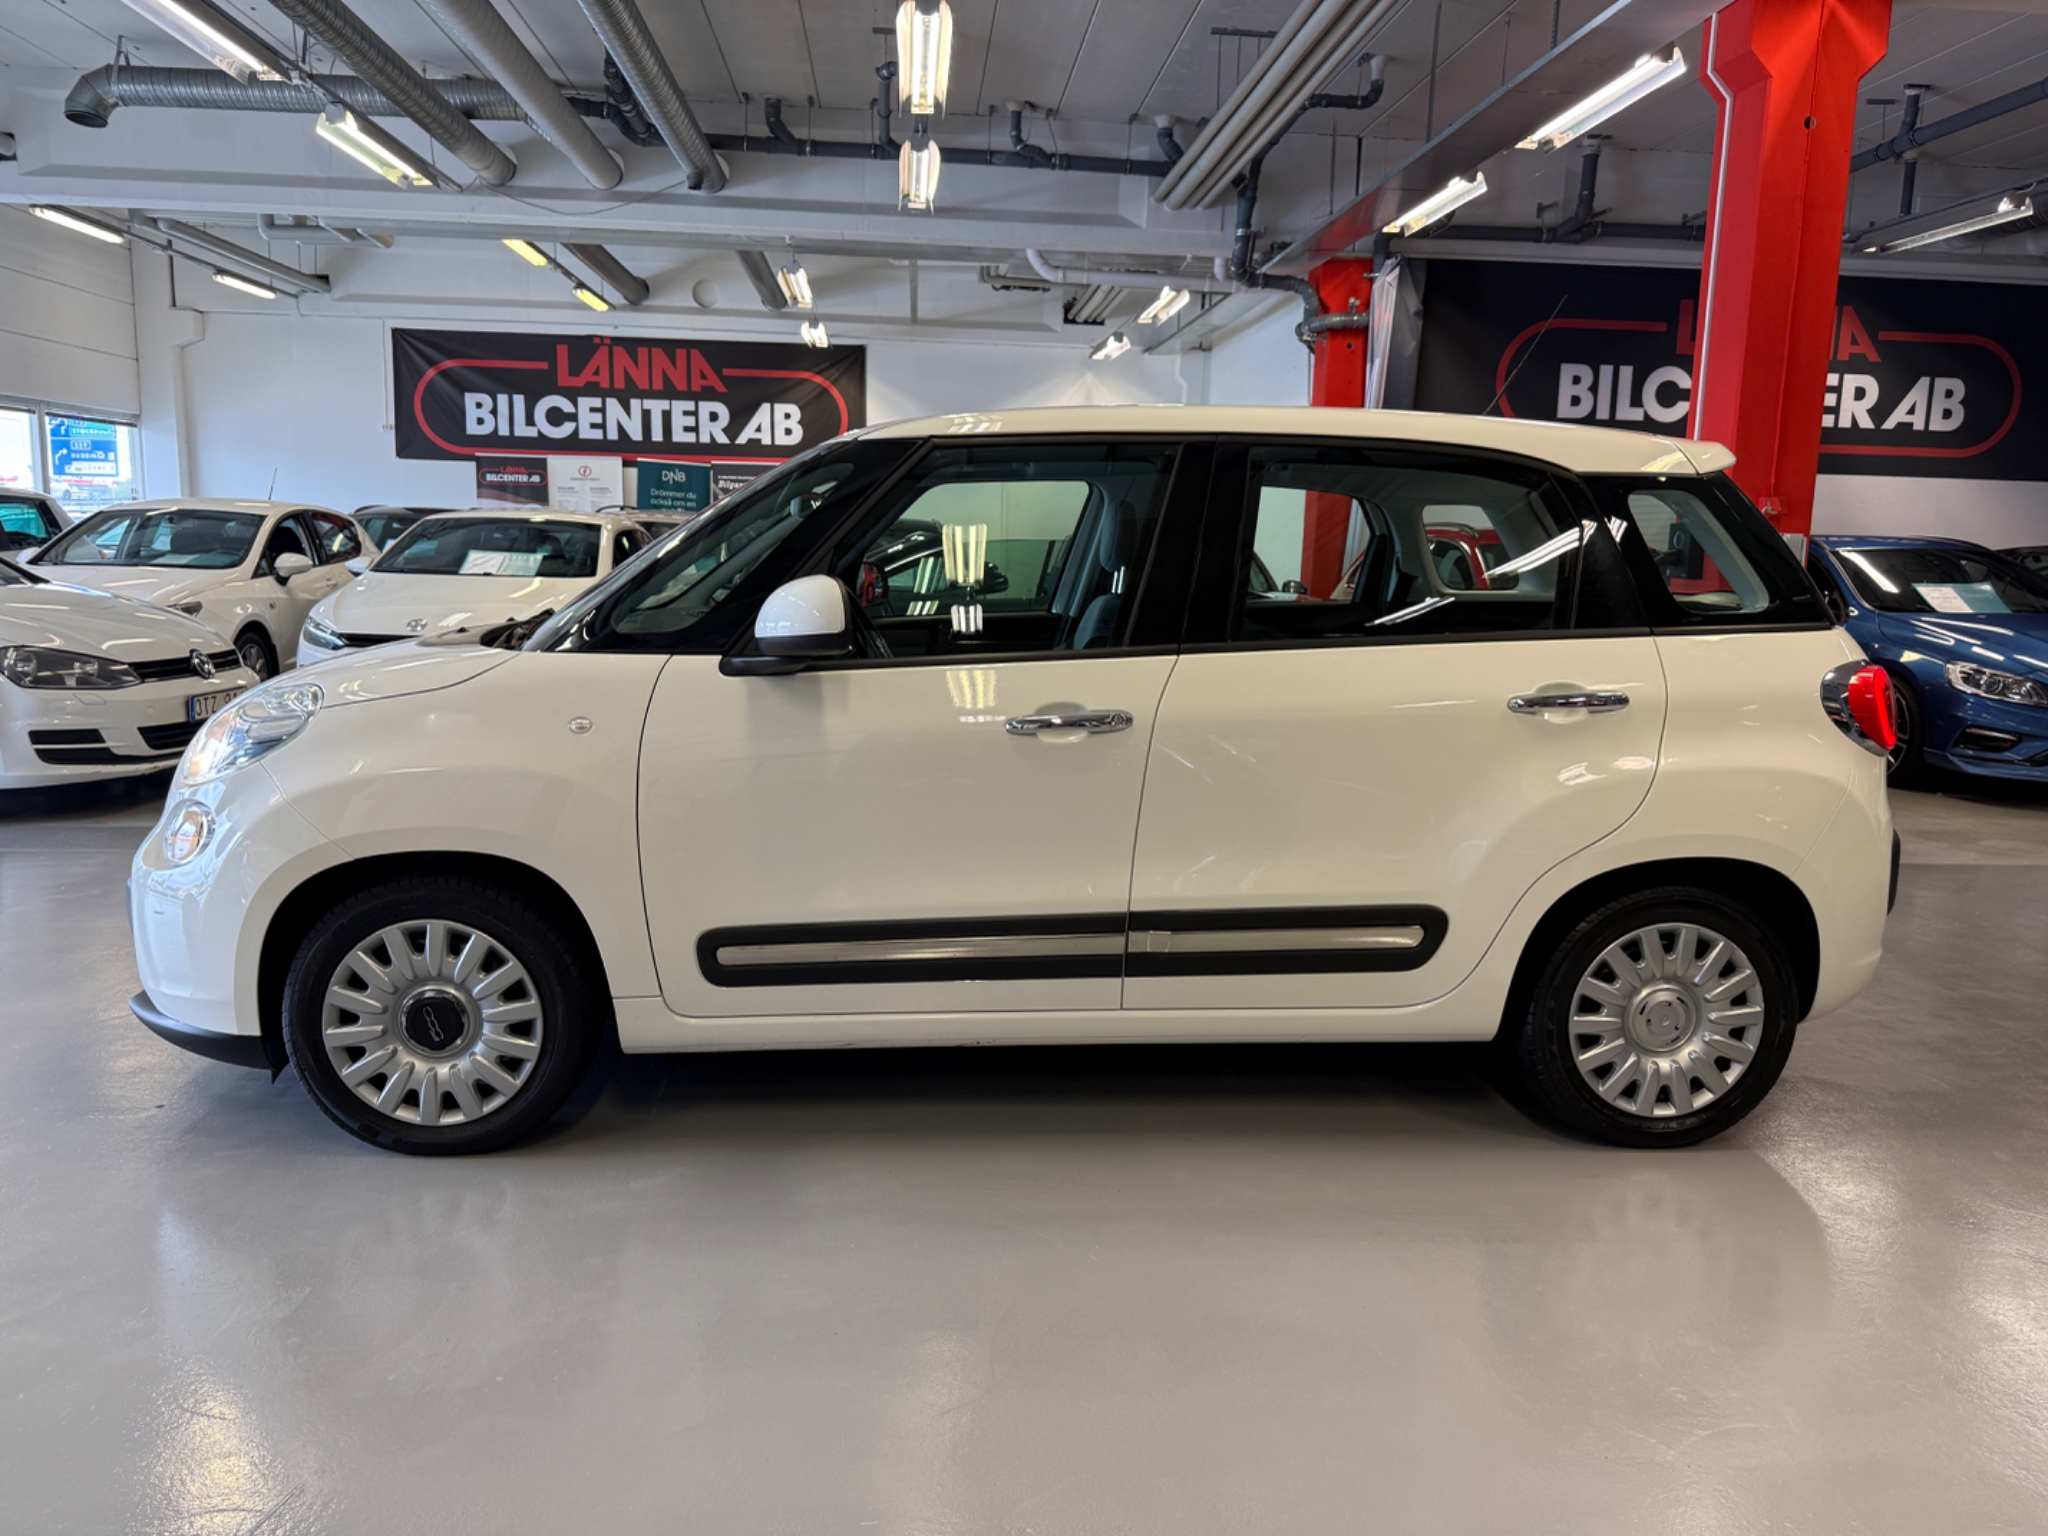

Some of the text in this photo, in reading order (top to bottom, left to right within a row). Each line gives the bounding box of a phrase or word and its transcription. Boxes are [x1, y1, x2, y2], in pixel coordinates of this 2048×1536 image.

[556, 337, 728, 393] LÄNNA
[1881, 376, 1966, 432] AB
[464, 392, 804, 446] BILCENTER AB
[485, 473, 528, 482] BILCENTER
[500, 465, 528, 474] LÄNNA
[661, 468, 686, 484] DNB
[650, 488, 697, 499] Drömmer du
